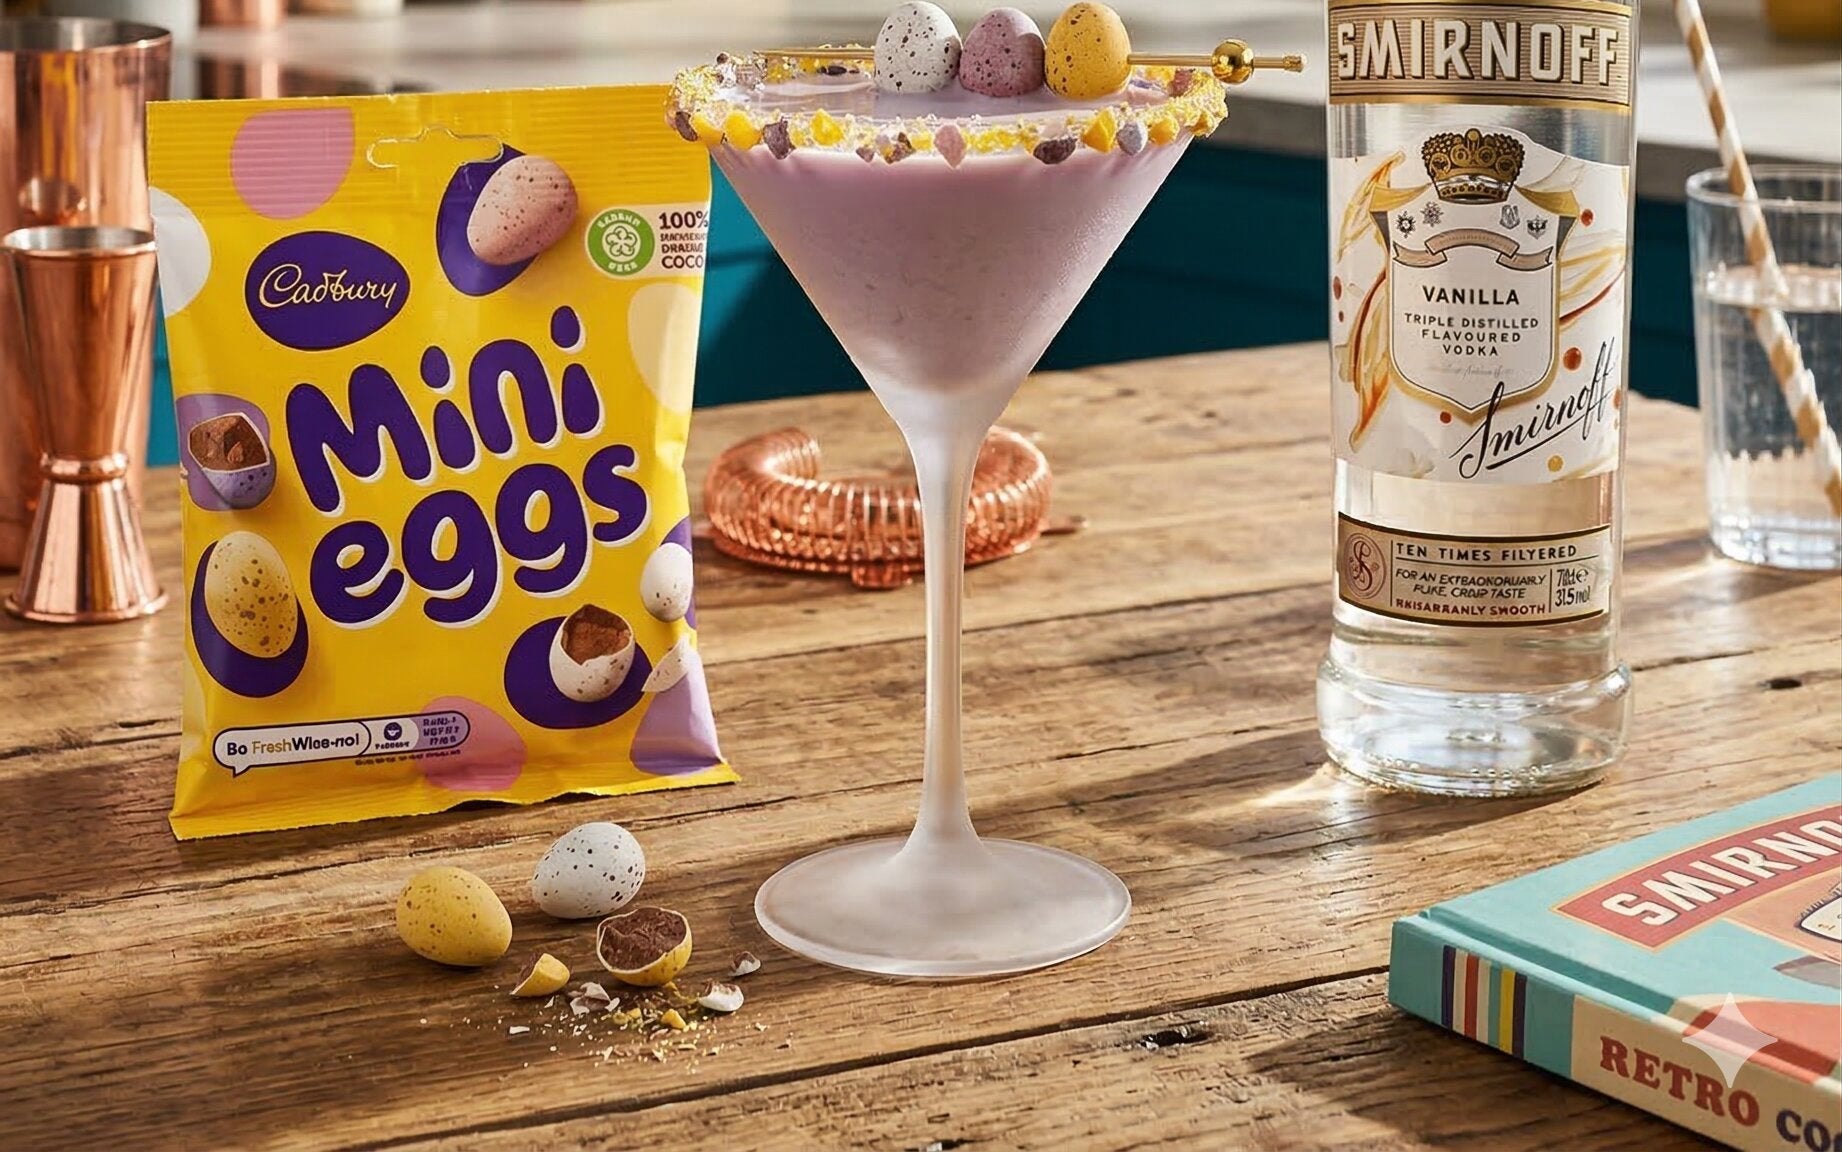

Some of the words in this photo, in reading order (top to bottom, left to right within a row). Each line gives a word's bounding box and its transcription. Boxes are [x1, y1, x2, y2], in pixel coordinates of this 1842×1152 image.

[1337, 17, 1619, 87] SMIRNOFF
[658, 210, 709, 230] 100%
[259, 263, 397, 309] Cadbury
[1422, 285, 1520, 305] VANILLA
[1404, 312, 1455, 328] TRIPLE
[1461, 317, 1539, 329] DISTILLED
[1421, 328, 1521, 343] FLAVOURED
[1442, 344, 1498, 356] VODKA
[285, 305, 606, 516] Mini
[1449, 336, 1615, 480] Smirnoff
[309, 444, 652, 627] eggs
[1396, 542, 1428, 558] TEN
[1438, 547, 1492, 562] TIMES
[1395, 567, 1418, 580] FOR
[1419, 571, 1437, 583] AN
[1491, 587, 1527, 599] TASTE
[1599, 1036, 1761, 1128] RETRO
